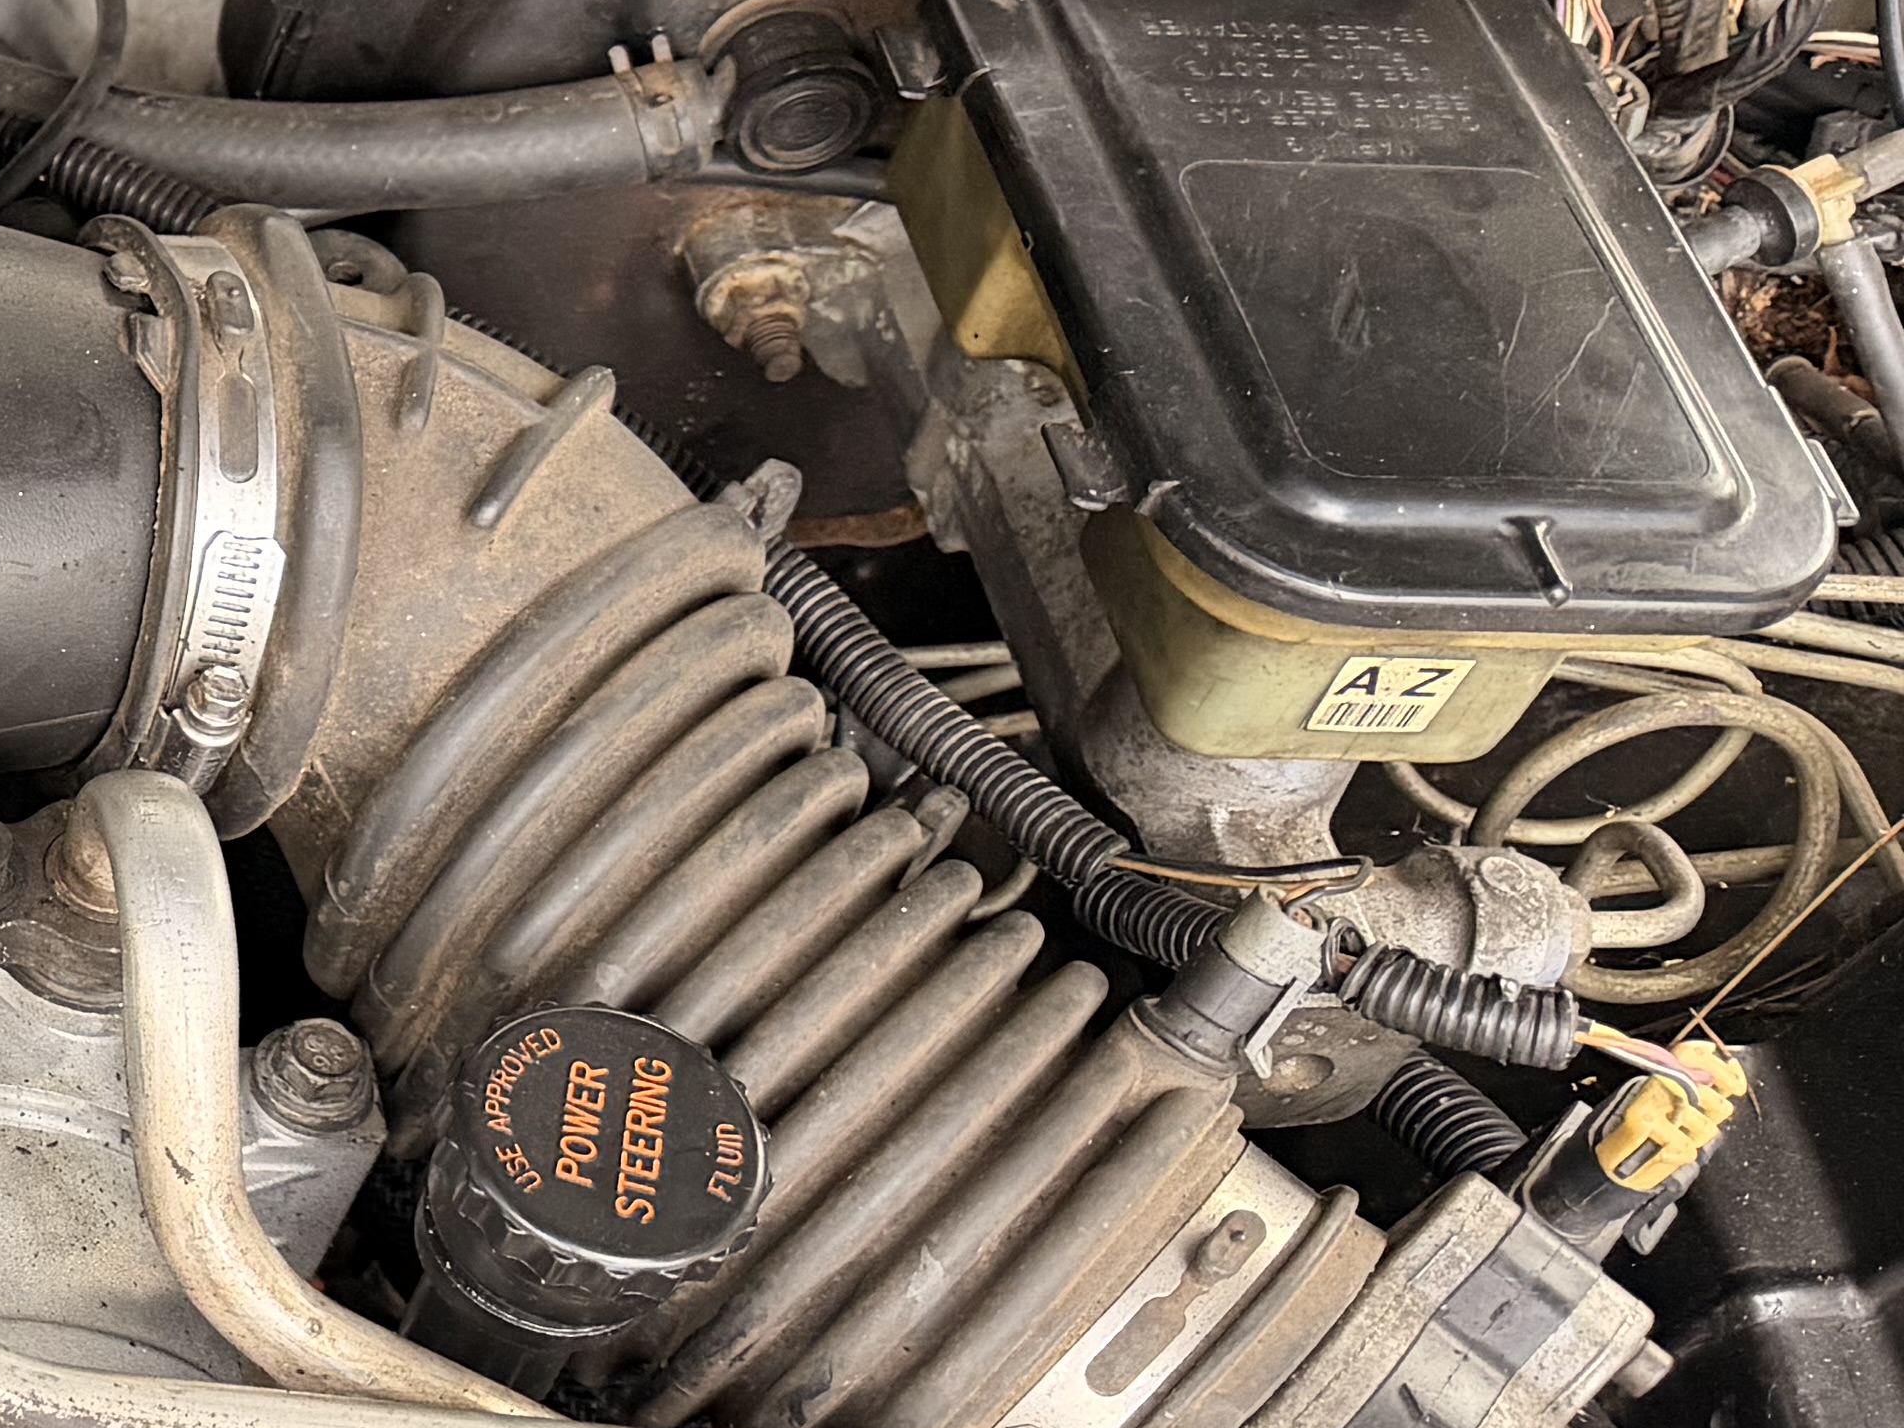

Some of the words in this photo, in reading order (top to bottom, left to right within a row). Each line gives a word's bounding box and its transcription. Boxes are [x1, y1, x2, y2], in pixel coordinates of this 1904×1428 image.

[483, 1027, 563, 1136] APPROVED
[555, 1060, 610, 1189] POWER
[494, 1142, 543, 1194] USE
[615, 1056, 674, 1225] STEERING
[706, 1122, 746, 1202] FLUID
